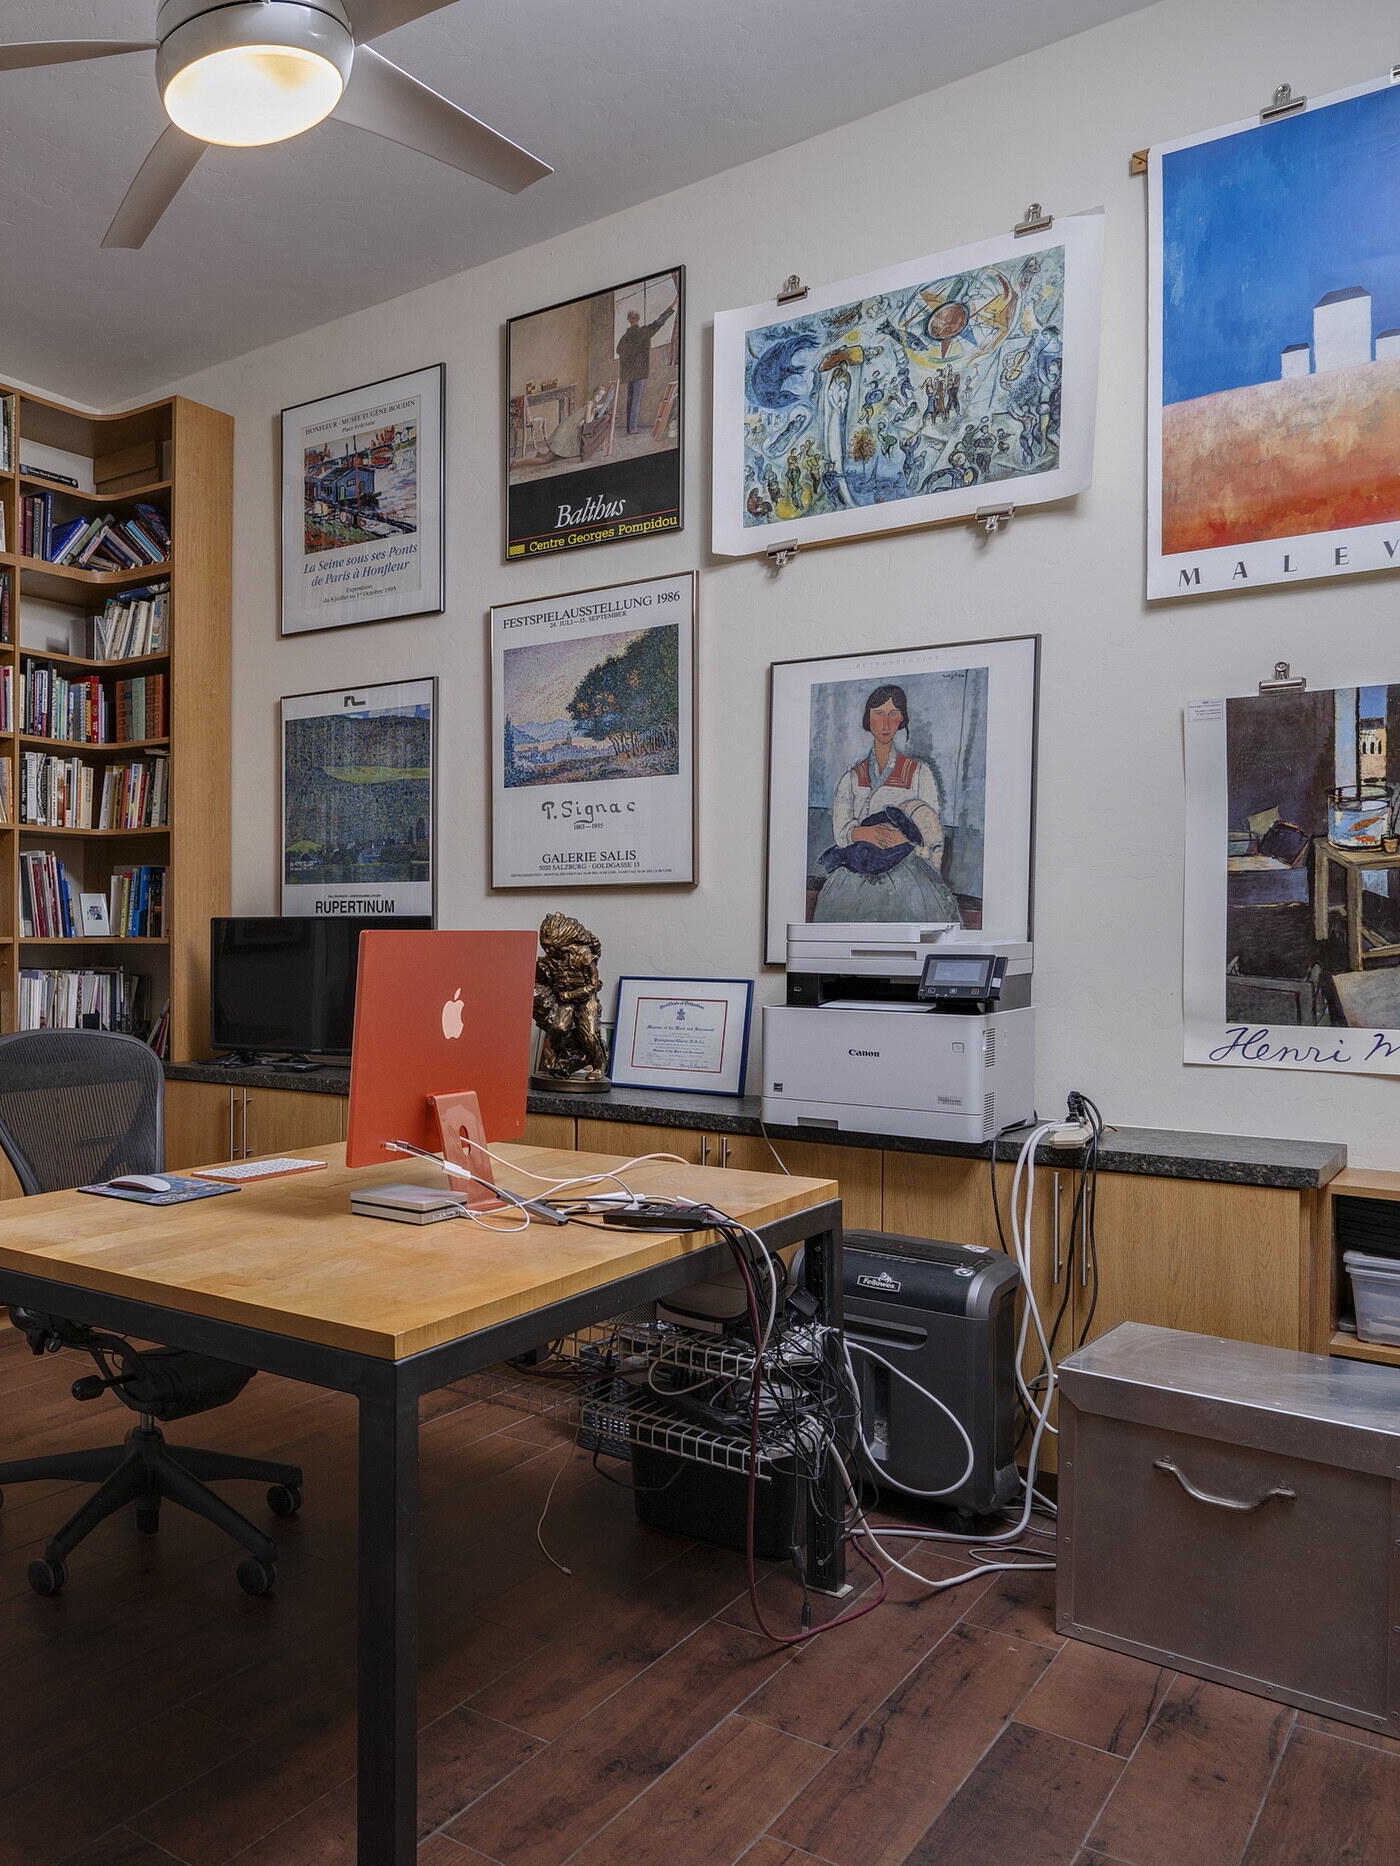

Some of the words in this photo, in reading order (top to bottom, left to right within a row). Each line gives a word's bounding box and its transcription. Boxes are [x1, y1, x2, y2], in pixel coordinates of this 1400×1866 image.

[389, 399, 416, 412] BOUDIN
[554, 494, 626, 529] Balthus
[529, 538, 565, 552] Centre
[568, 528, 615, 544] Georges
[618, 516, 678, 536] Pompidou
[303, 563, 316, 574] La
[318, 559, 345, 572] Seine
[346, 553, 369, 566] sous
[371, 550, 387, 561] ses
[388, 543, 418, 557] Ponts
[311, 575, 324, 587] de
[325, 570, 351, 584] Paris
[352, 567, 360, 579] à
[361, 560, 411, 578] Honfleur
[503, 595, 652, 630] FESTSPIELAUSSTELLUNG
[657, 590, 681, 604] 1986
[588, 610, 627, 623] SEPTEMBER
[541, 801, 557, 820] P.
[561, 800, 636, 824] Signac
[542, 852, 597, 864] GALERIE
[600, 850, 637, 861] SALIS
[315, 900, 395, 914] RUPERTINUM
[848, 1049, 880, 1058] Canon
[1209, 1027, 1352, 1062] Henri
[862, 1277, 896, 1289] Fellowes
